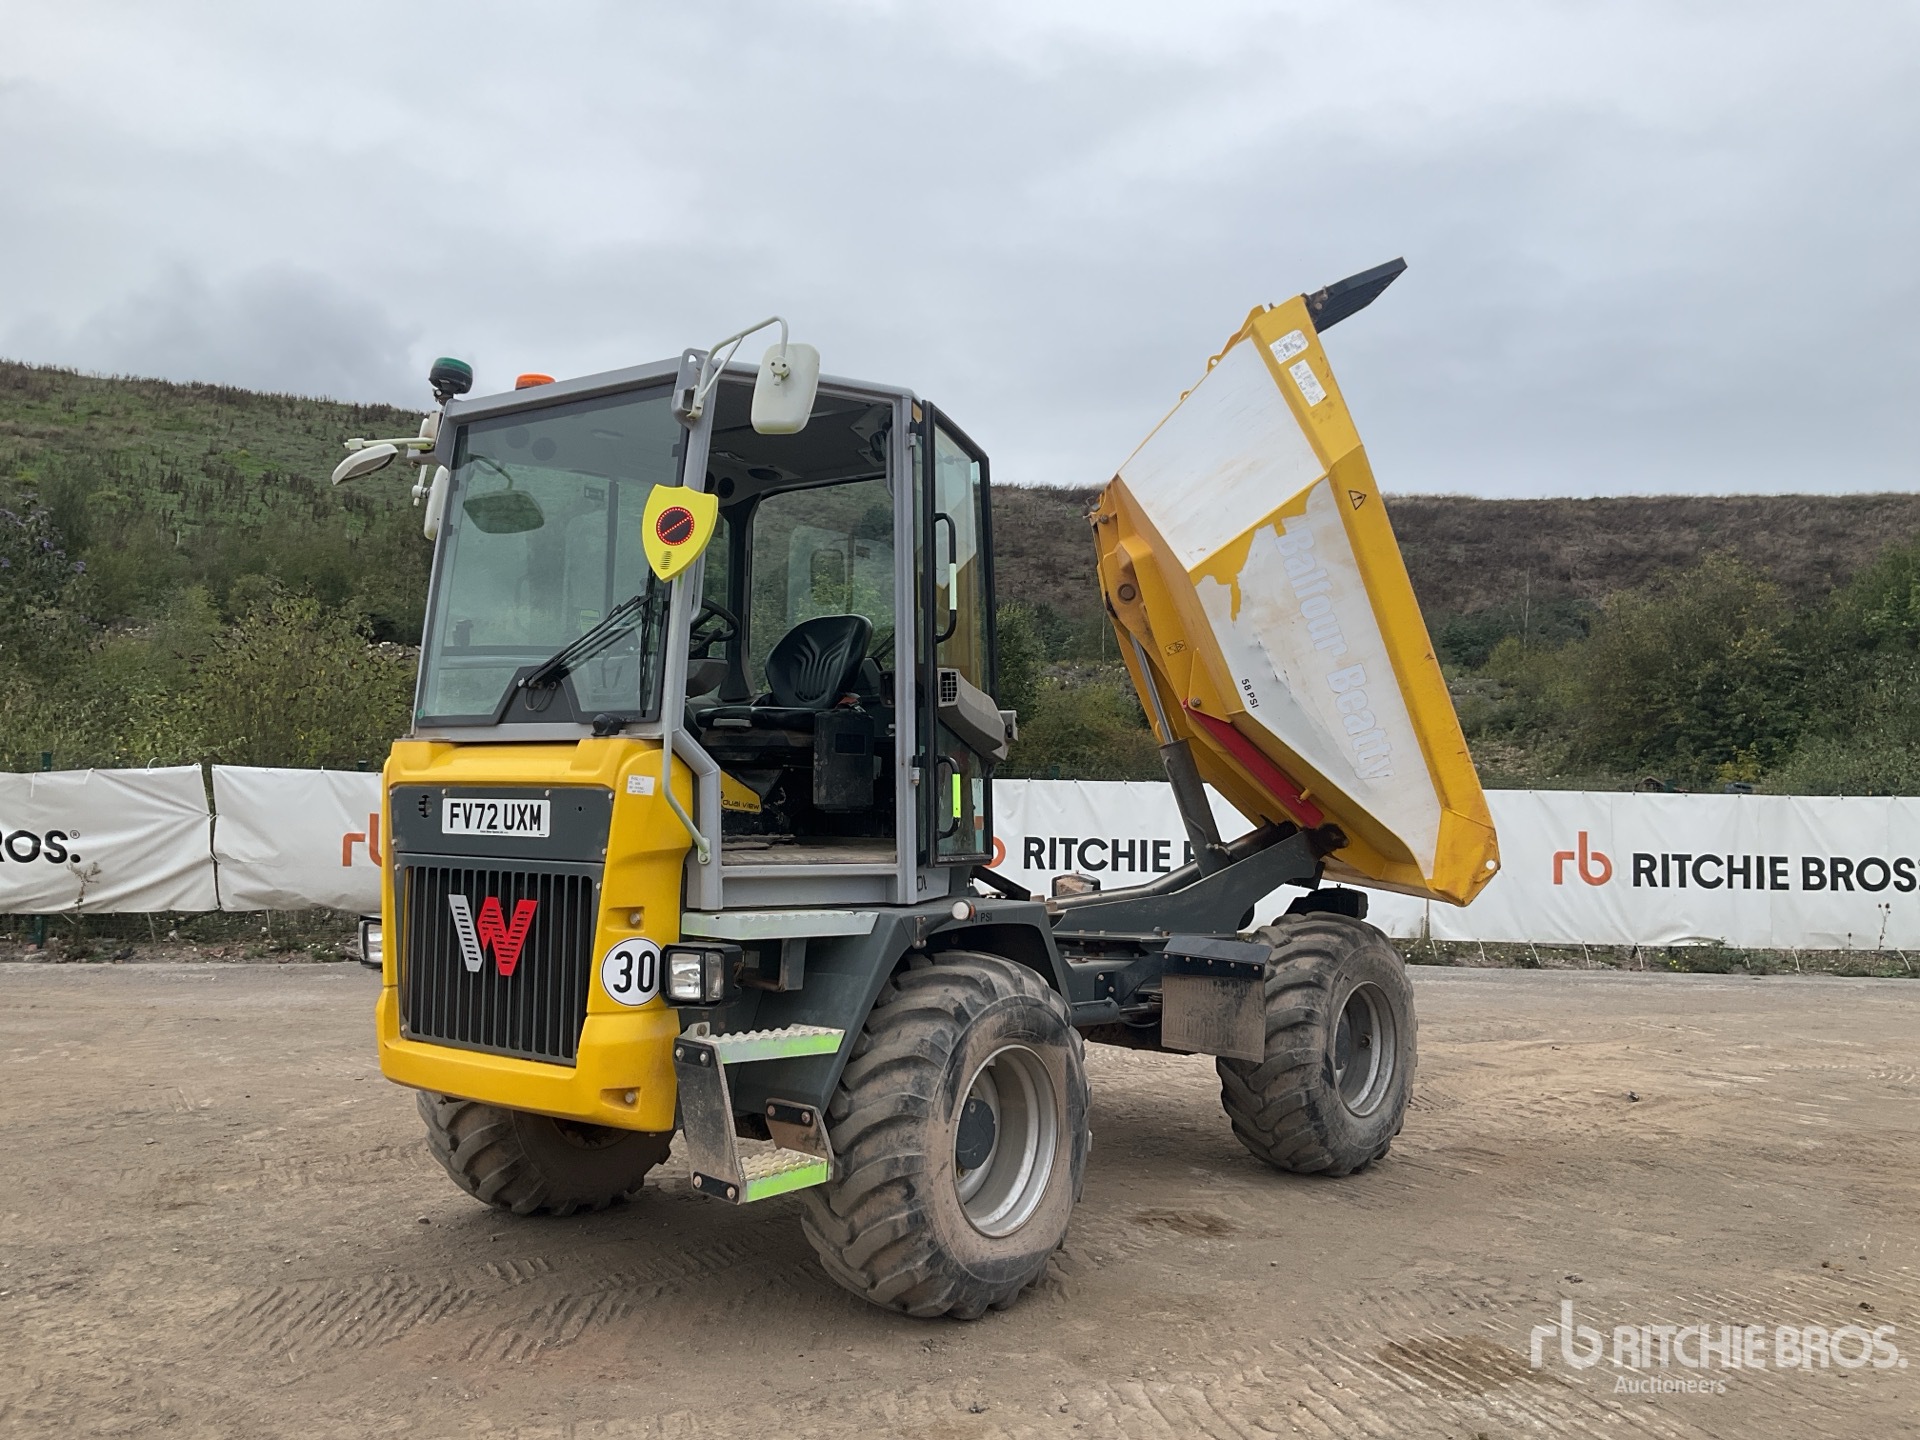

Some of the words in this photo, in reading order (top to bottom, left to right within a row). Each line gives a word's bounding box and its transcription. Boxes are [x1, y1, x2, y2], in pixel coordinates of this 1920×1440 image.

[1274, 526, 1348, 657] Balfour
[1326, 663, 1395, 781] Beatty
[1241, 678, 1252, 691] 58
[1247, 692, 1259, 709] PSI
[450, 803, 498, 830] FV72
[504, 804, 542, 831] UXM
[1023, 836, 1171, 872] RITCHIE
[1553, 831, 1613, 886] rb
[1632, 853, 1790, 891] RITCHIE
[1801, 856, 1920, 892] BROS
[980, 912, 993, 922] PSI
[612, 950, 657, 993] 30
